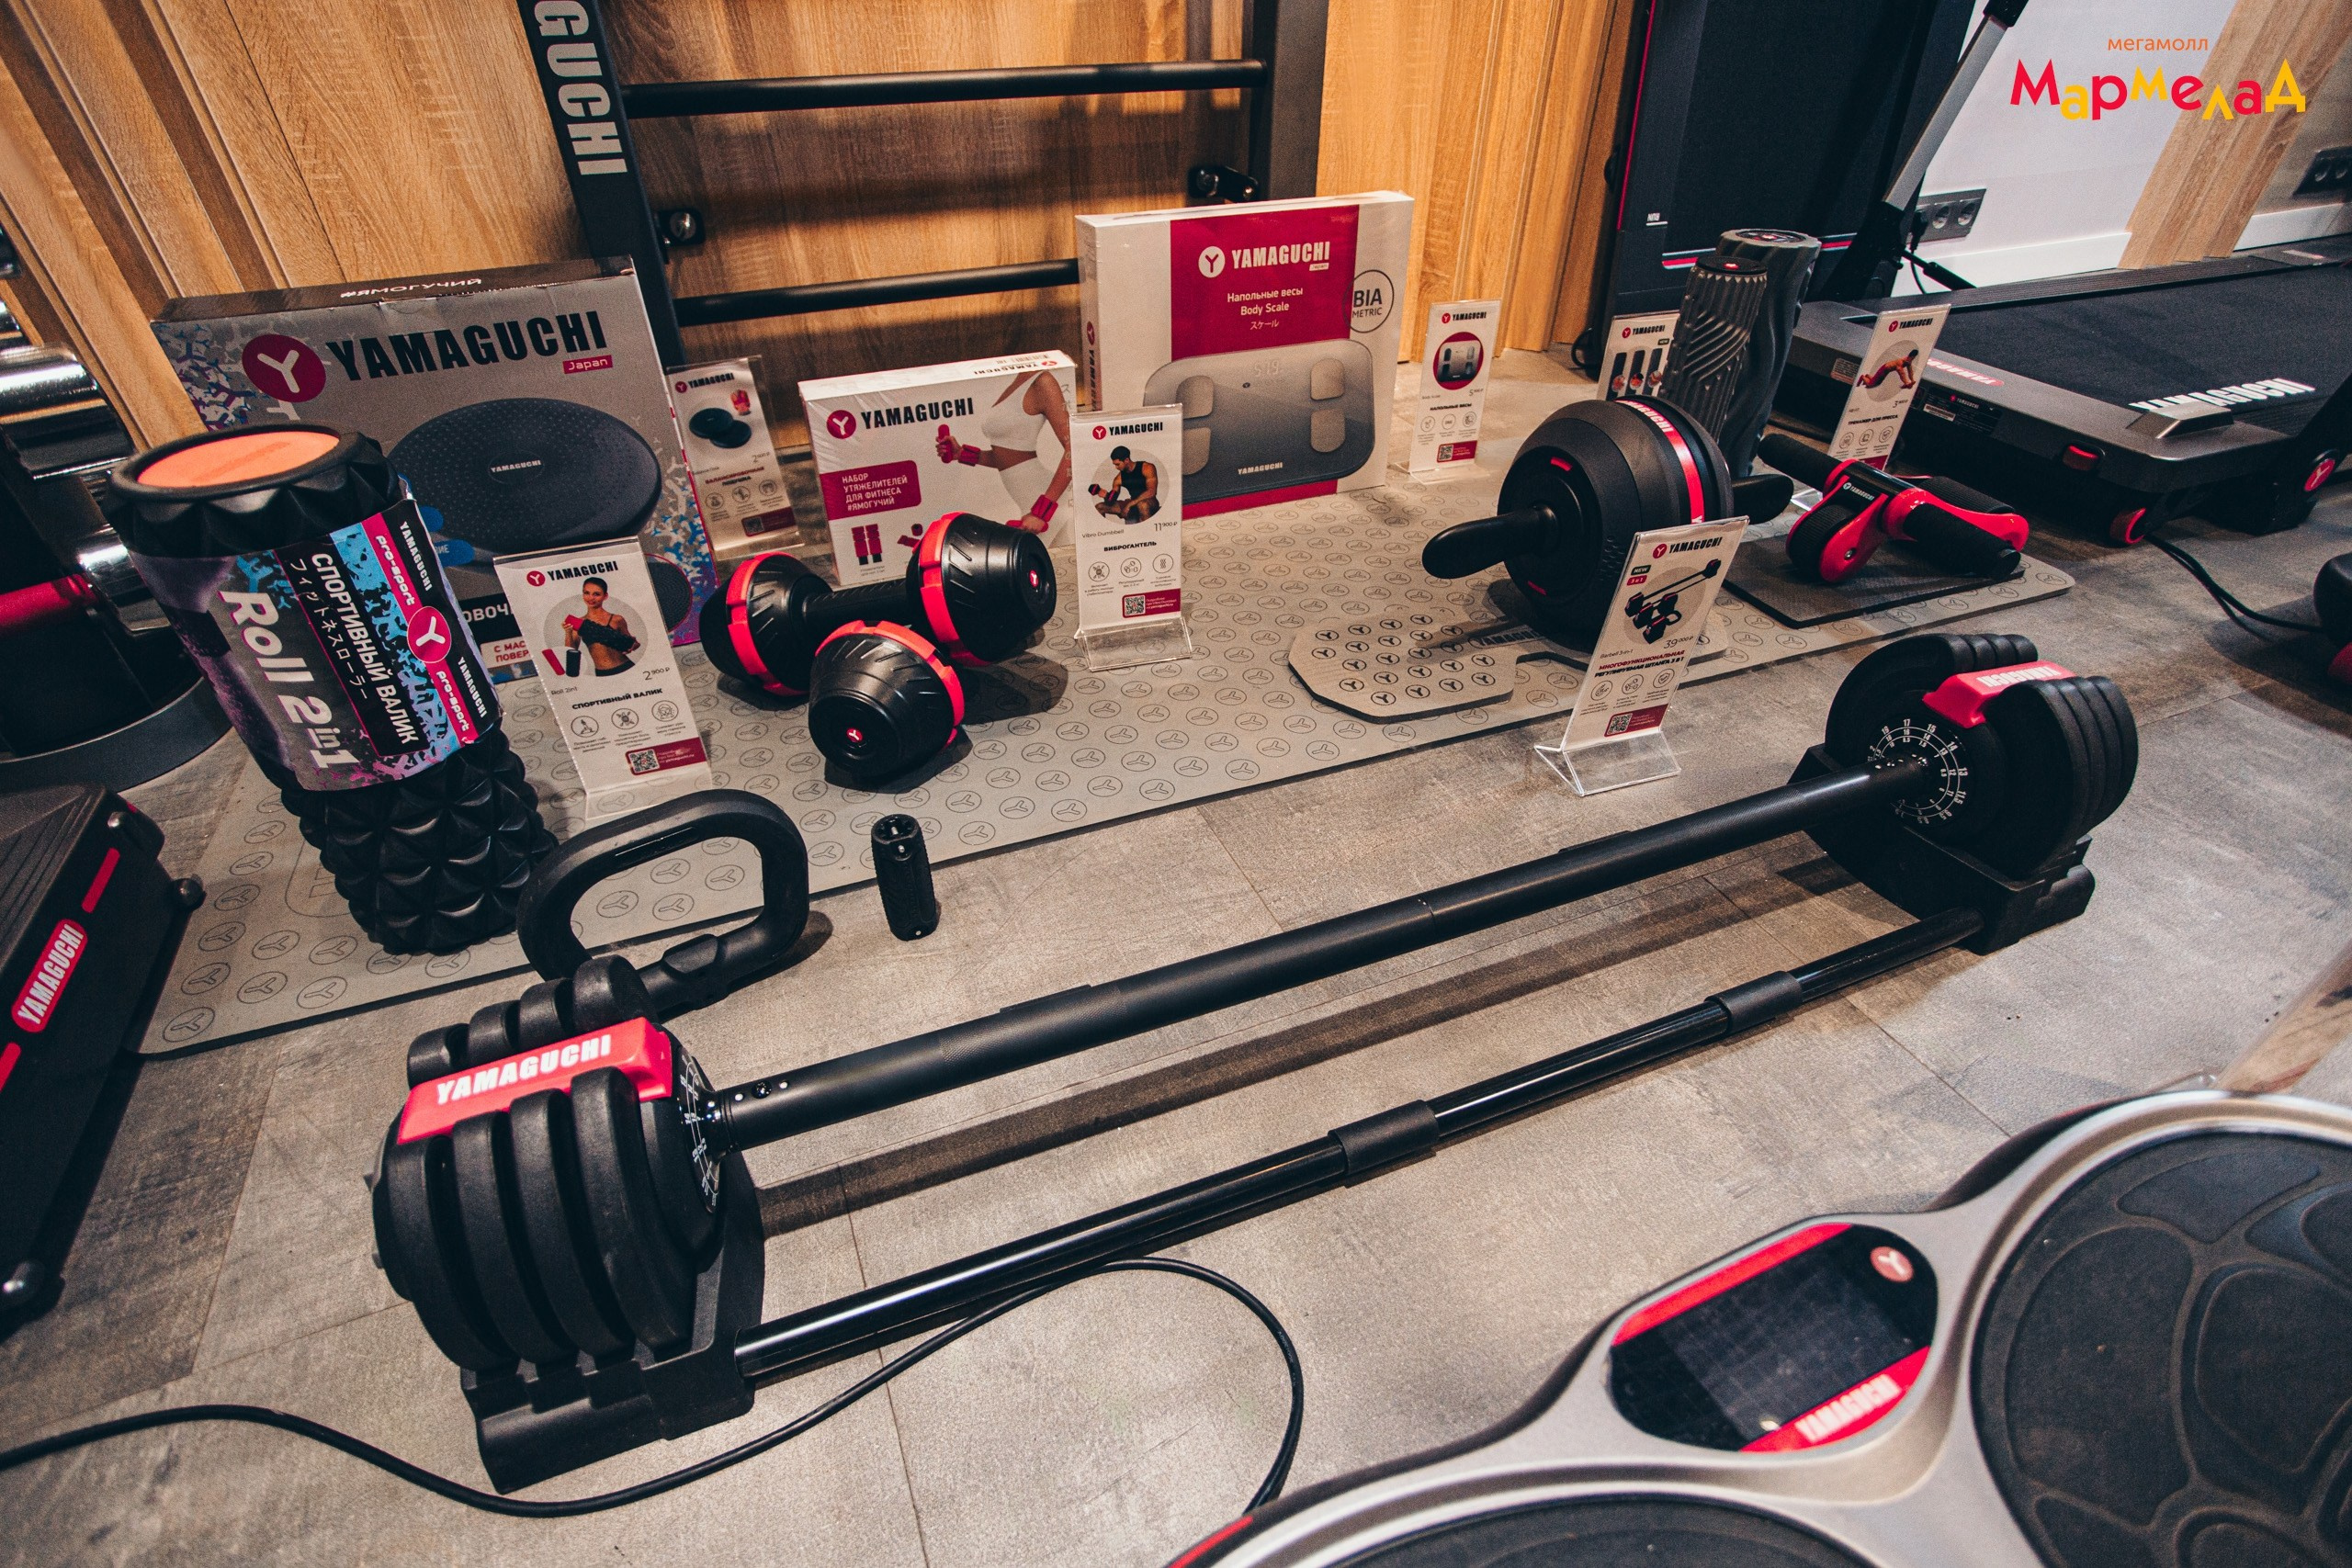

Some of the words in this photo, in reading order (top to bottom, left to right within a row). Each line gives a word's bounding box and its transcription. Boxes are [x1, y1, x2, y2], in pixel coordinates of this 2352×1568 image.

[1232, 242, 1330, 270] YAMAGUCHI
[340, 278, 482, 299] #ЯМОГУЧИЙ
[1227, 289, 1279, 303] Напольные
[1281, 287, 1304, 298] весы
[1352, 288, 1383, 308] BIA
[1240, 305, 1262, 316] Body
[1265, 301, 1290, 313] Scale
[1351, 307, 1383, 319] METRIC
[326, 310, 607, 381] YAMAGUCHI
[568, 357, 608, 372] Japan
[861, 398, 974, 429] YAMAGUCHI
[1109, 422, 1164, 436] YAMAGUCHI
[491, 459, 542, 474] YAMAGUCHI
[1238, 462, 1283, 475] YAMAGUCHI
[842, 472, 869, 484] НАБОР
[843, 475, 908, 493] УТЯЖЕЛИТЕЛЕЙ
[845, 493, 863, 503] ДЛЯ
[865, 487, 902, 499] ФИТНЕСА
[847, 496, 895, 512] #ЯМОГУЧИЙ
[1103, 541, 1157, 551] ВИБРОГАНТЕЛЬ
[1669, 537, 1723, 553] YAMAGUCHI
[399, 521, 433, 592] YAMAGUCHI
[548, 560, 618, 581] YAMAGUCHI
[462, 603, 513, 623] ОВОЧ
[217, 591, 315, 682] Roll
[311, 553, 393, 682] СПОРТИВНЫЙ
[376, 678, 420, 745] ВАЛИК
[496, 649, 531, 662] ПОВЕР
[1594, 663, 1645, 678] РЕГУЛИРУЕМАЯ
[1645, 660, 1670, 669] ШТАНГА
[1599, 650, 1685, 670] МНОГОФУНКЦИОНАЛЬНАЯ
[458, 656, 488, 718] YAMAGUCHI
[571, 693, 632, 710] СПОРТИВНЫЙ
[633, 688, 662, 699] ВАЛИК
[17, 923, 85, 1025] YAMAGUCHI
[436, 1034, 612, 1104] YAMAGUCHI
[1794, 1373, 1904, 1444] YAMAGUCHI
